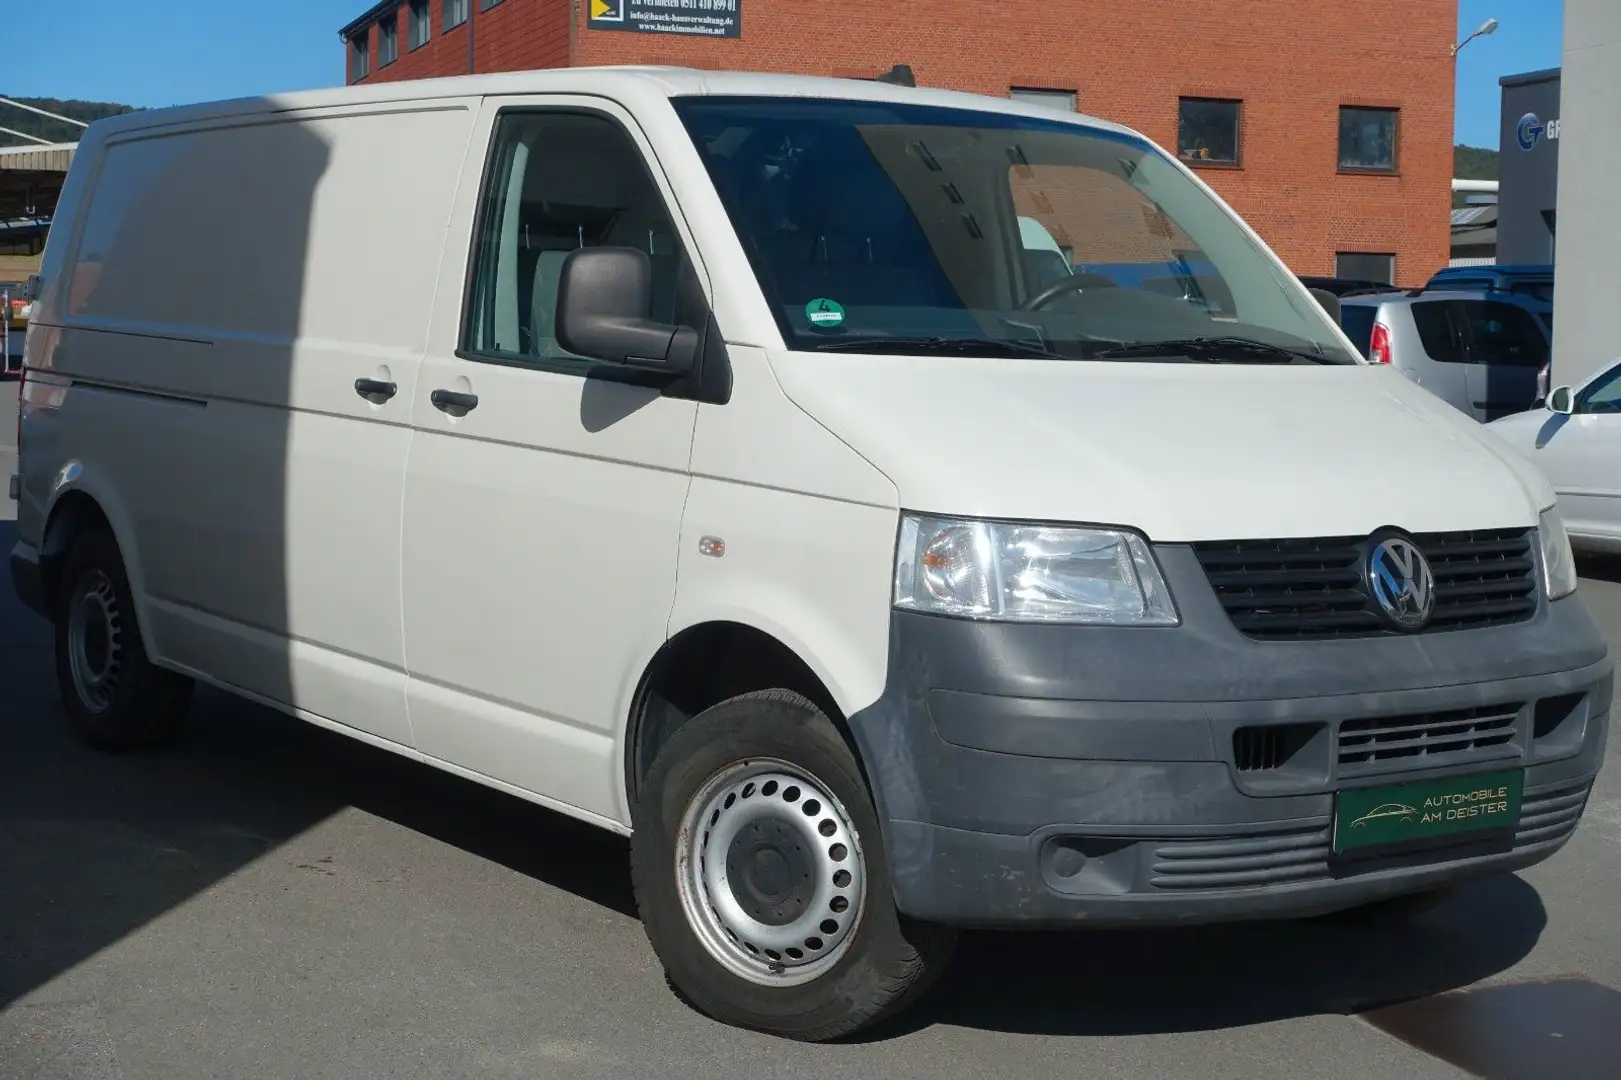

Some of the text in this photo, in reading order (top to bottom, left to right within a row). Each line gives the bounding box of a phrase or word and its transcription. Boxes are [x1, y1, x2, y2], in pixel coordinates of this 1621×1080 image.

[638, 23, 725, 34] www.haackimmobilien.net
[1424, 787, 1508, 808] AUTOMOBILE
[1420, 801, 1507, 824] AM DEISTER
